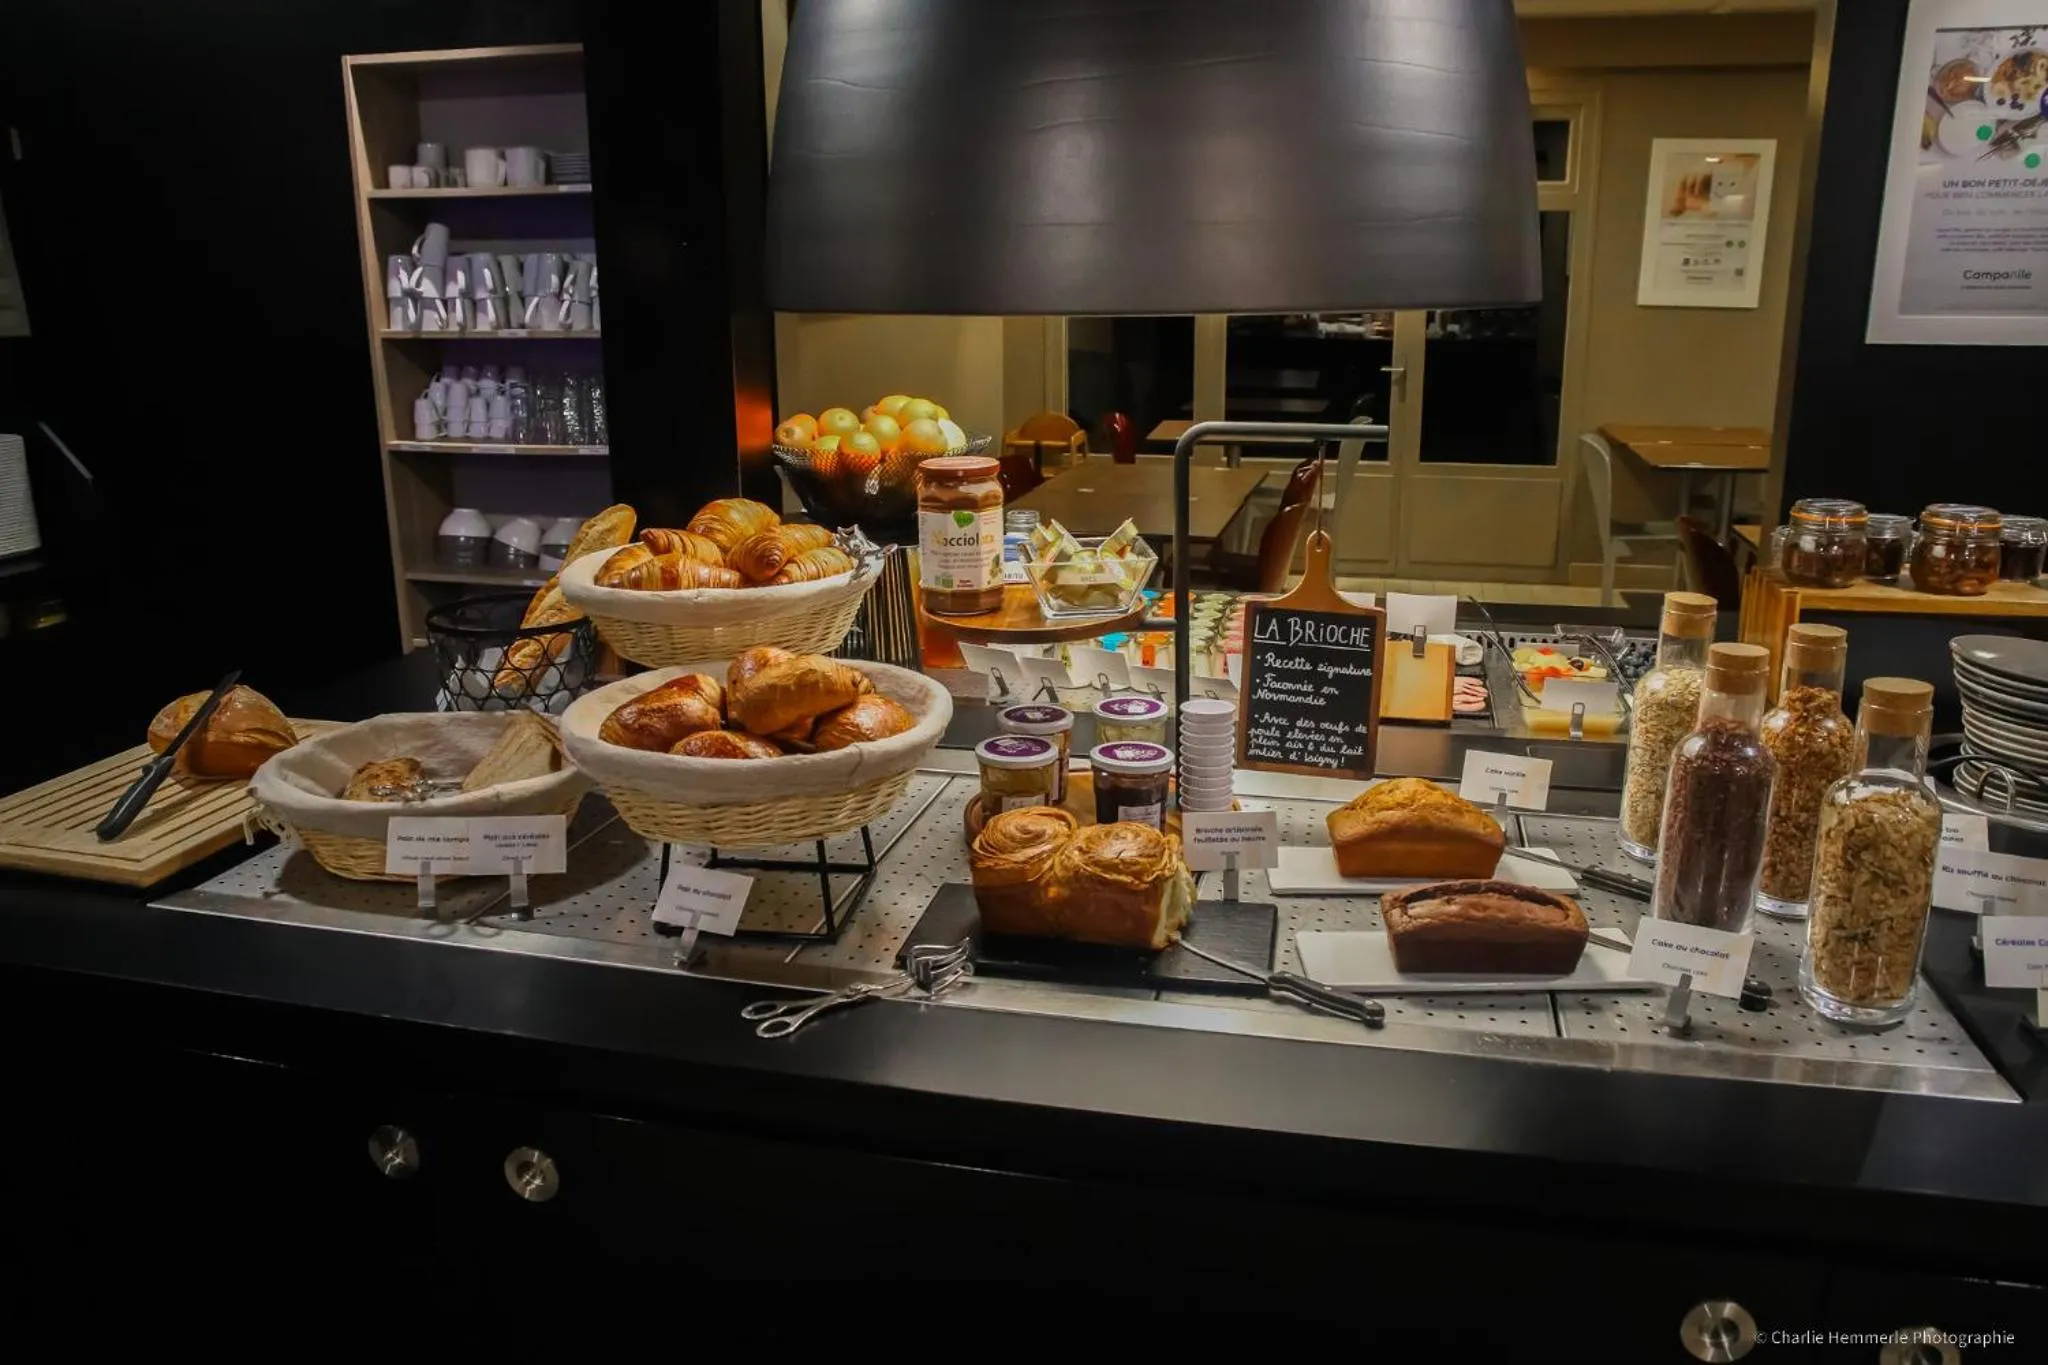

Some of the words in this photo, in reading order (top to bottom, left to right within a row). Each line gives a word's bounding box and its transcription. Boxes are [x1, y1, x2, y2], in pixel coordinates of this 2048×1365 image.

[1963, 269, 2033, 282] Campanile
[1254, 614, 1280, 641] LA
[1264, 652, 1312, 670] Recette
[1317, 662, 1372, 680] signature
[1252, 688, 1326, 706] Normandie
[1320, 685, 1340, 696] en
[1260, 712, 1290, 726] Avec
[1296, 717, 1316, 728] des
[1354, 723, 1368, 734] de
[1249, 736, 1280, 748] plein
[1285, 740, 1304, 749] air
[1320, 742, 1336, 753] du
[1339, 744, 1364, 755] lait
[1328, 735, 1344, 744] en
[1651, 938, 1674, 948] Cake
[1676, 944, 1688, 952] au
